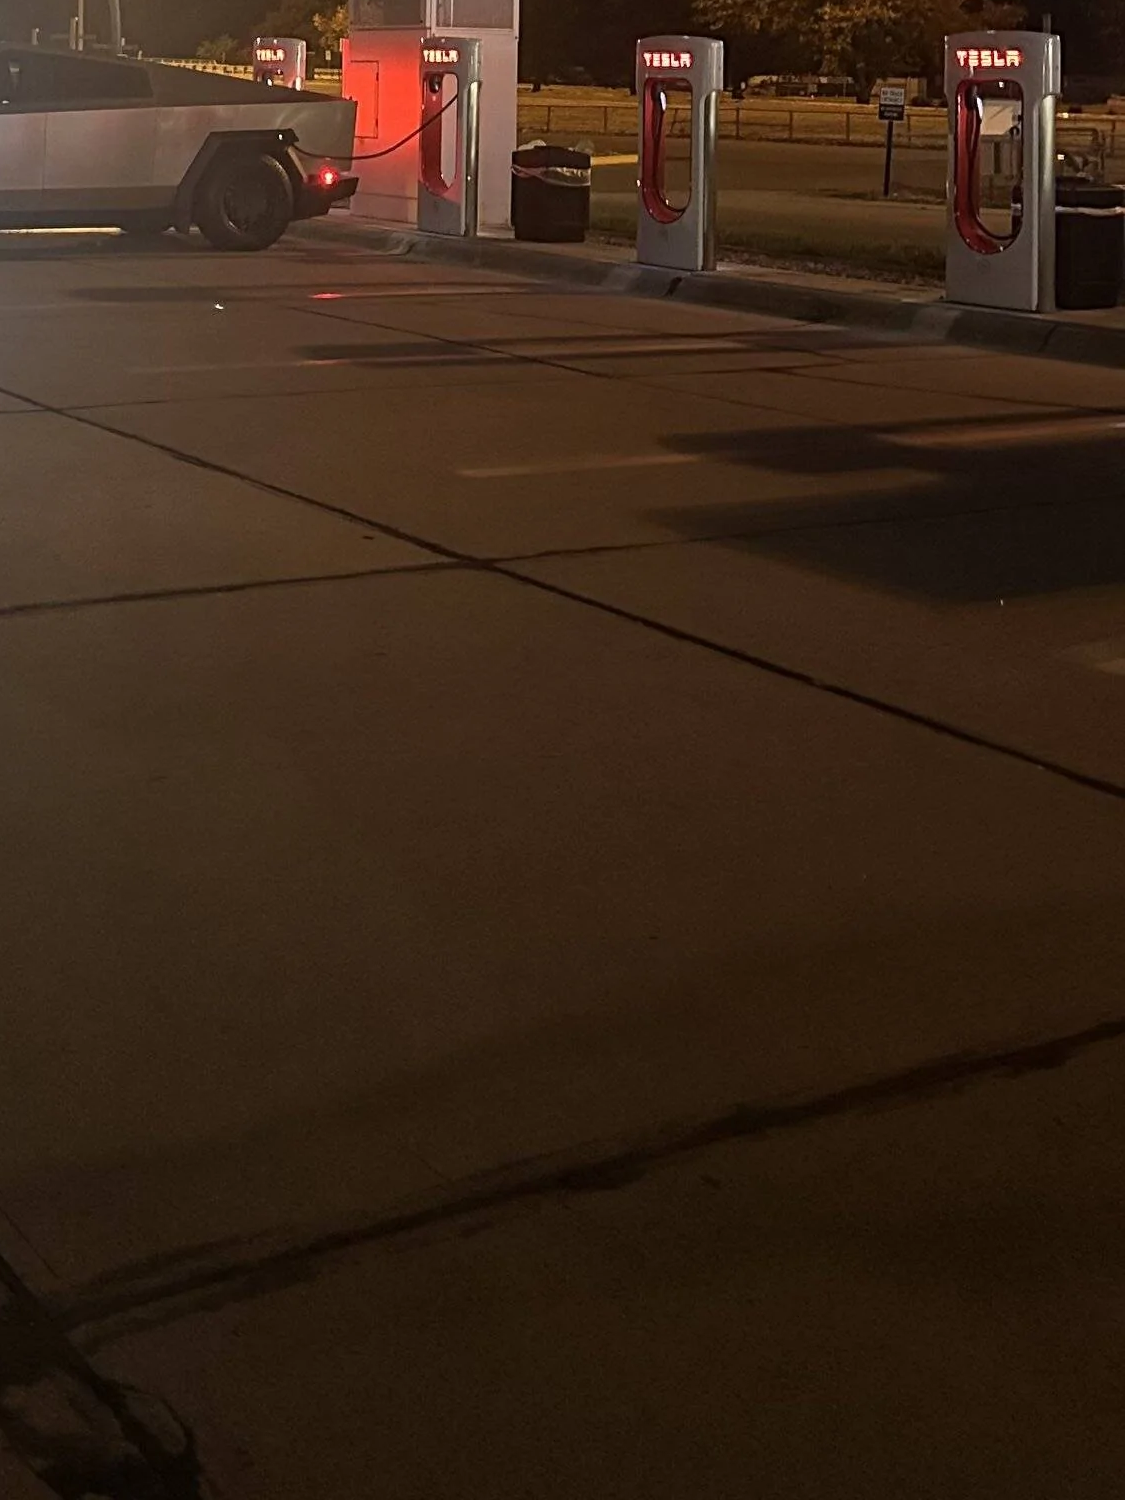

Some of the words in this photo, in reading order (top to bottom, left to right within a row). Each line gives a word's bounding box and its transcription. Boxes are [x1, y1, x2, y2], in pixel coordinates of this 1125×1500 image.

[256, 49, 284, 61] TESLA
[423, 49, 458, 63] TESLA
[643, 52, 692, 68] TESLA
[956, 49, 1021, 68] TESLA
